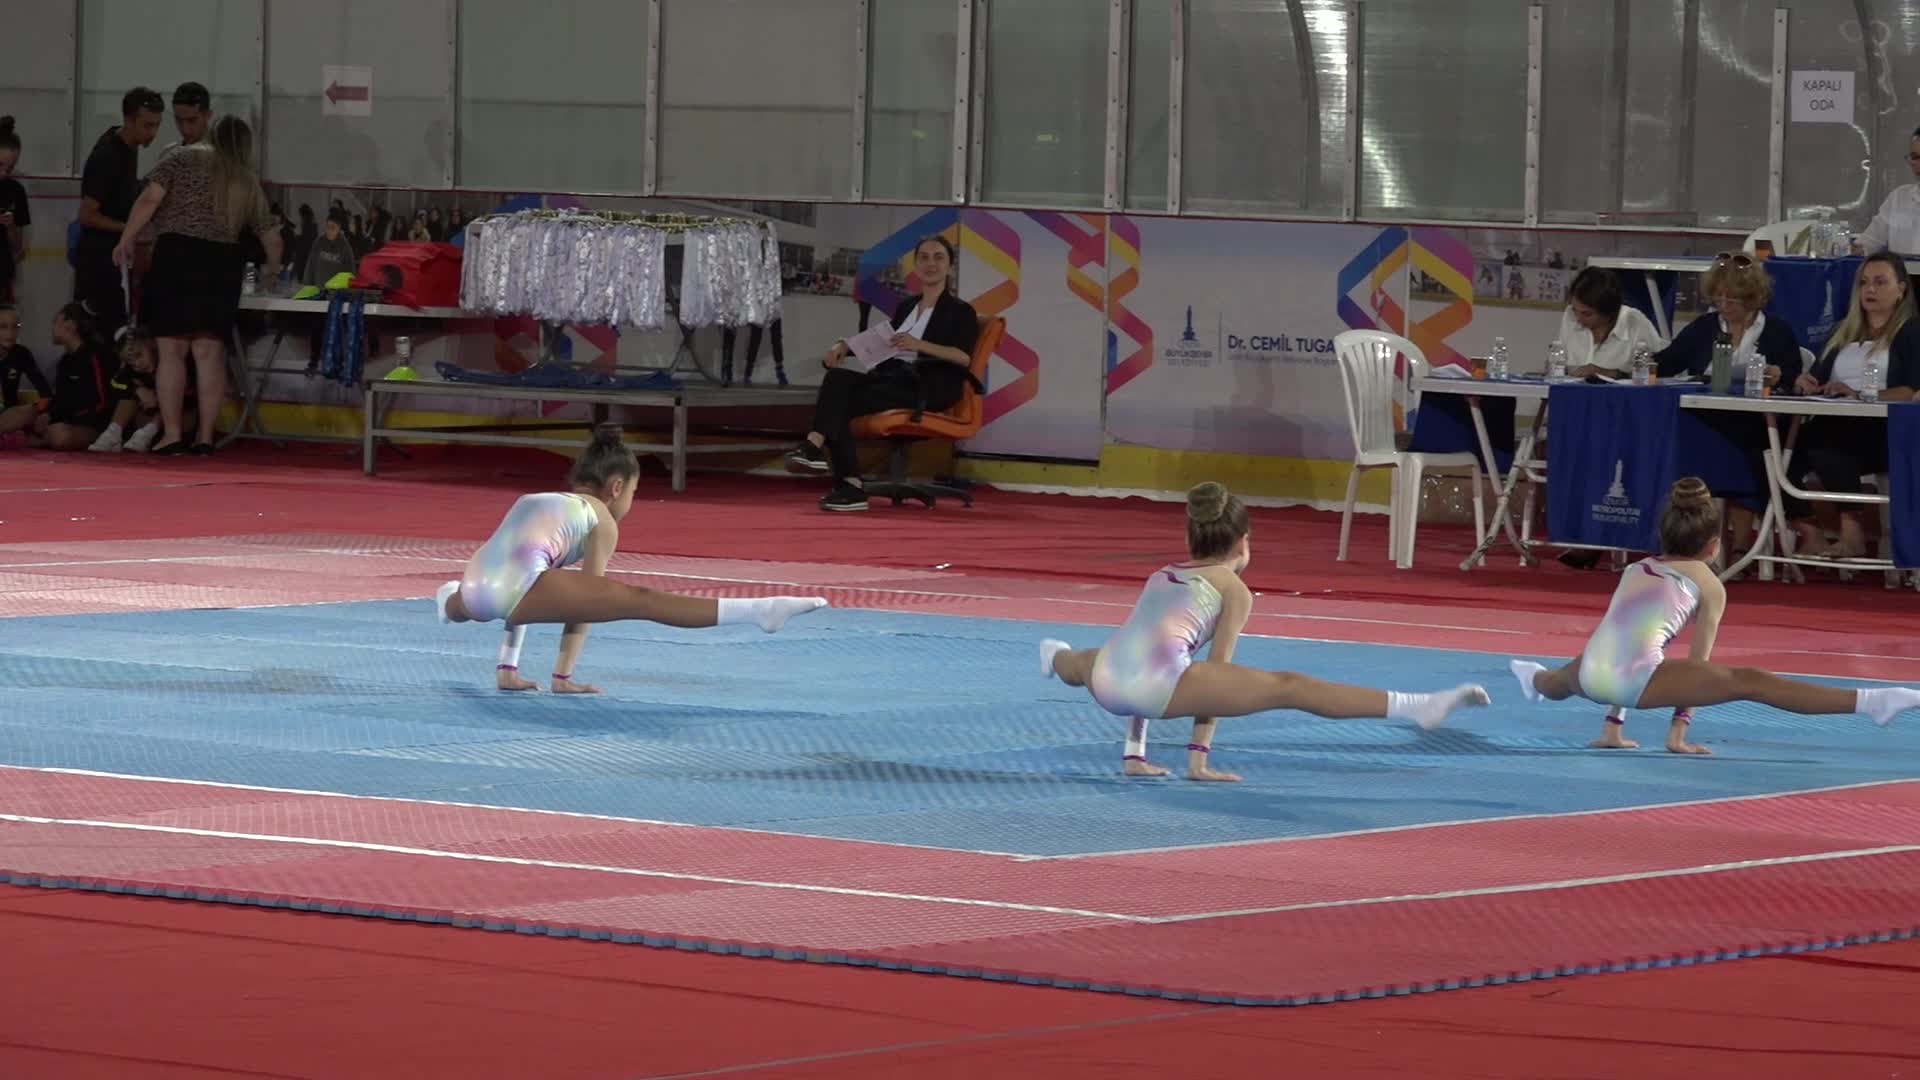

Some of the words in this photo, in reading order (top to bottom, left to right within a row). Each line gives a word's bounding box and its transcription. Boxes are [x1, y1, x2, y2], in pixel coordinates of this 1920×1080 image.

[1803, 80, 1841, 91] KAPALI
[1810, 99, 1835, 111] ODA
[1228, 334, 1246, 349] Dr.
[1250, 333, 1292, 352] CEMİL
[1296, 337, 1336, 353] TUGA
